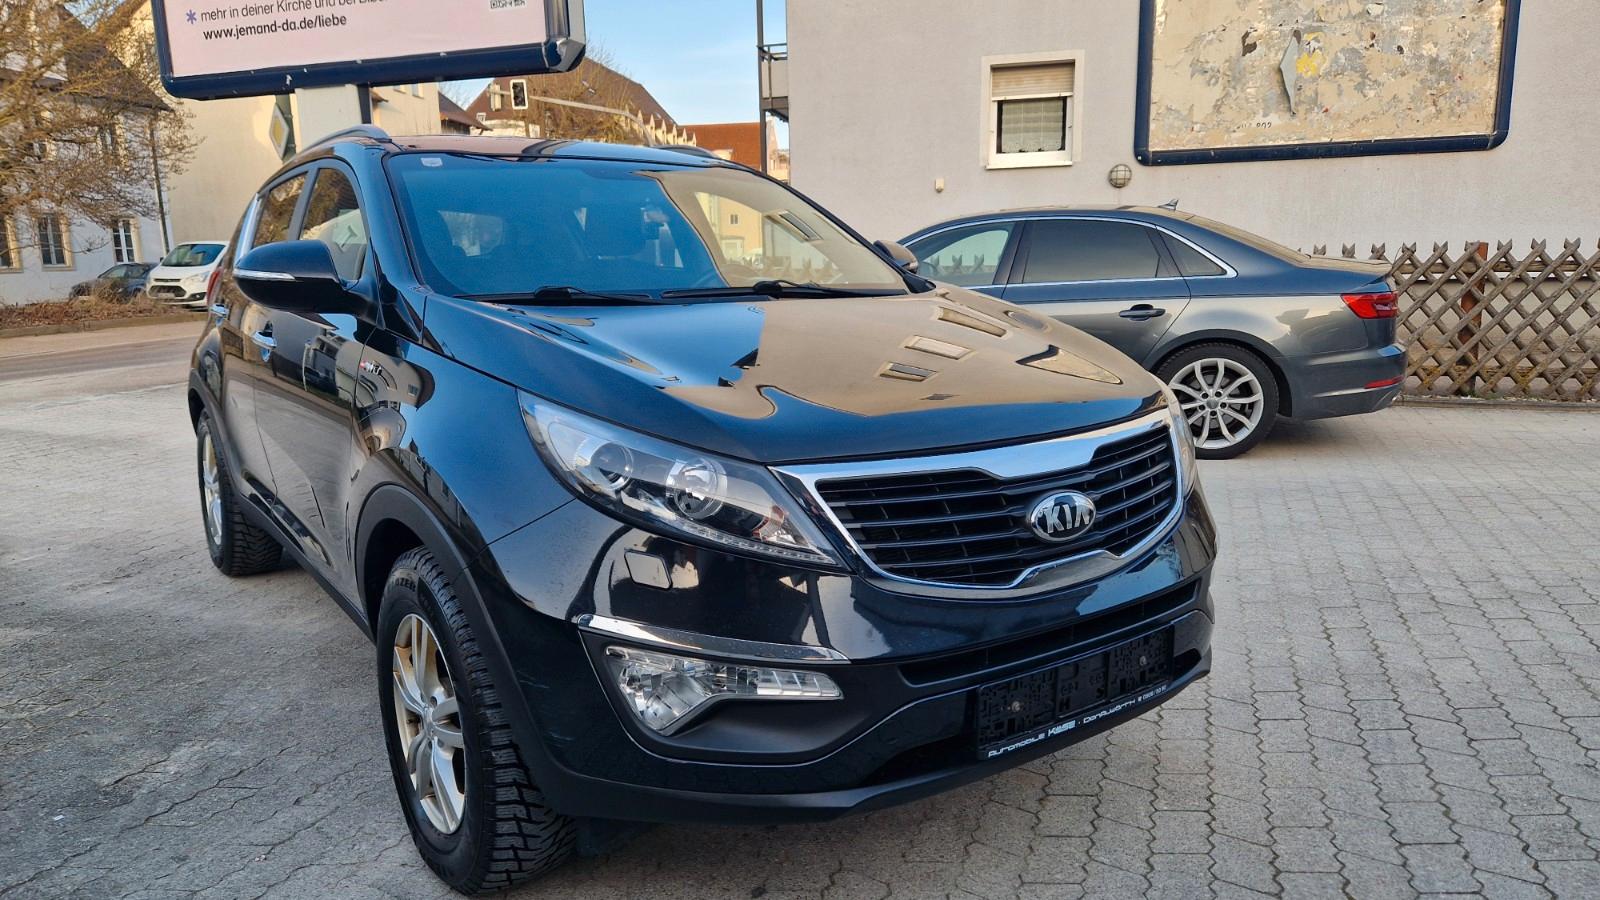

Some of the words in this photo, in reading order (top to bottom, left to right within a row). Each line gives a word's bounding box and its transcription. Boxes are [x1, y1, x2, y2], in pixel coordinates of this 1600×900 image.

[201, 8, 227, 22] mehr
[229, 6, 239, 18] in
[241, 4, 274, 17] deiner
[277, 0, 312, 13] Kirche
[203, 14, 347, 40] www.jemand-da.de/liebe
[1043, 503, 1090, 534] KIA
